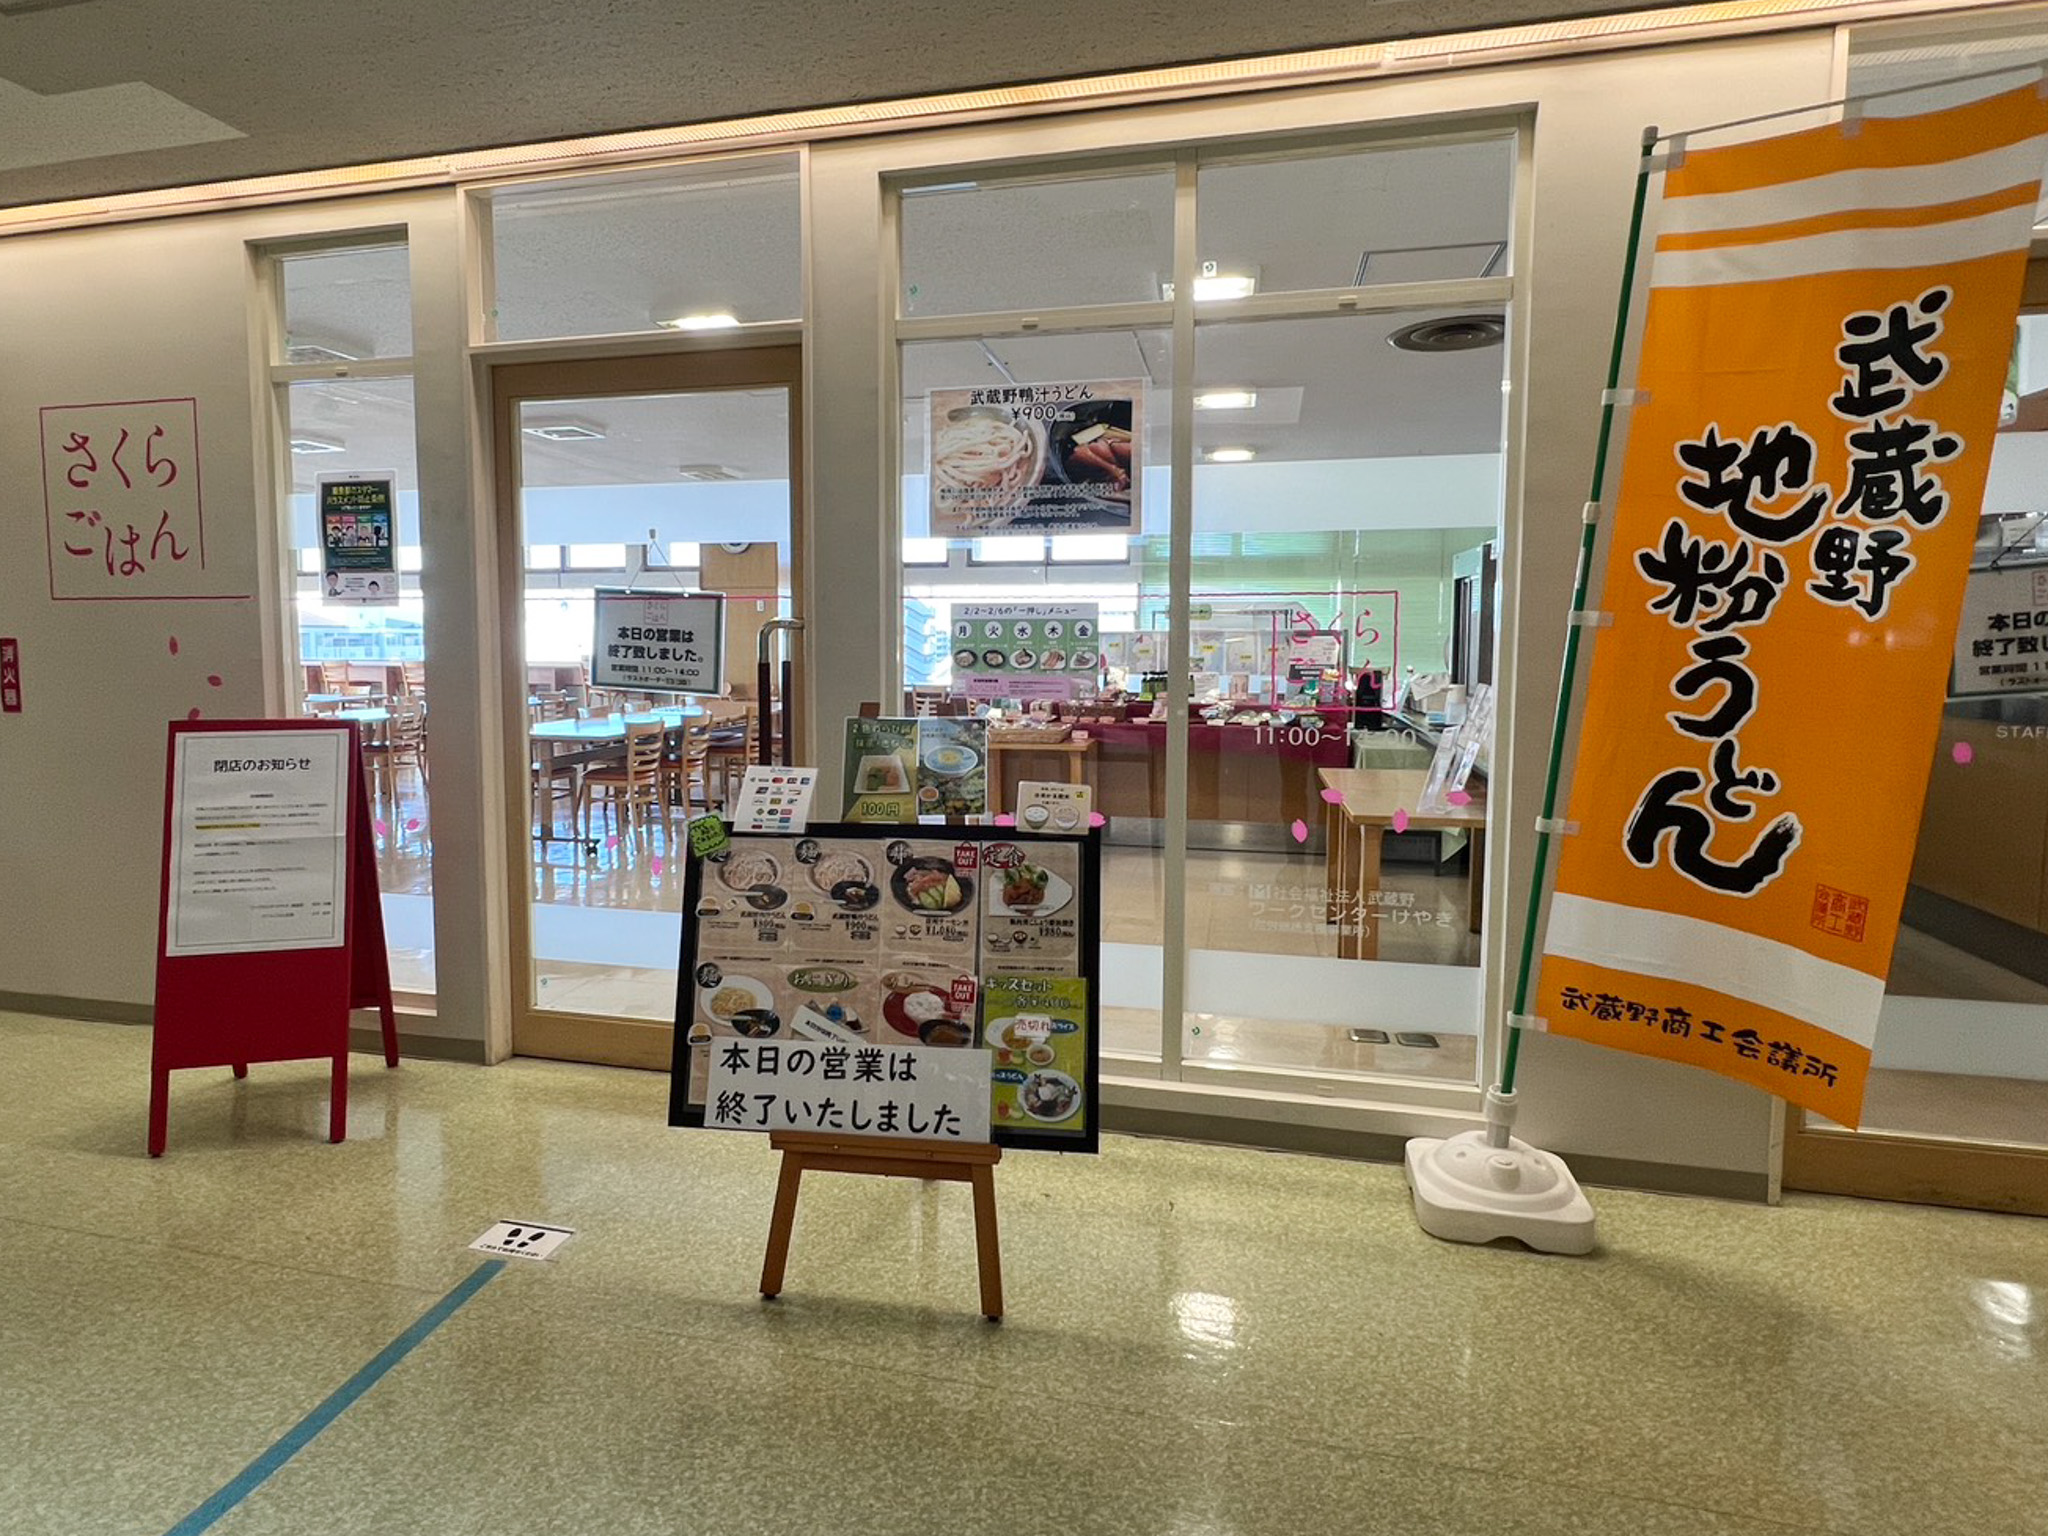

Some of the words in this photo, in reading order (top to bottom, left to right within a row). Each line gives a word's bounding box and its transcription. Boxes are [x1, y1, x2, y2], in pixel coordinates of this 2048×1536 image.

[970, 386, 1094, 405] 武蔵野鴨汁うどん
[1011, 406, 1056, 421] ¥900
[62, 424, 178, 489] さくら
[1812, 288, 1963, 616] 武蔵野
[63, 510, 190, 577] ごはん
[617, 626, 694, 643] 本日の営業は
[958, 625, 967, 636] 月
[988, 625, 999, 637] 火
[1017, 626, 1028, 637] 水
[1048, 625, 1059, 636] 木
[1078, 625, 1090, 637] 金
[607, 644, 704, 663] 終了致しました。
[1625, 424, 1827, 895] 地粉うどん
[2, 646, 18, 706] 消火器
[213, 758, 312, 773] 閉店のお知らせ
[861, 801, 901, 816] 100円
[956, 850, 977, 858] TAKE
[1251, 901, 1453, 928] ワークセンターけやき
[795, 972, 848, 988] おにぎり
[1560, 986, 1839, 1088] 武蔵野商工会議所
[720, 1041, 917, 1083] 本日の営業は
[714, 1090, 961, 1136] 終了いたしました
